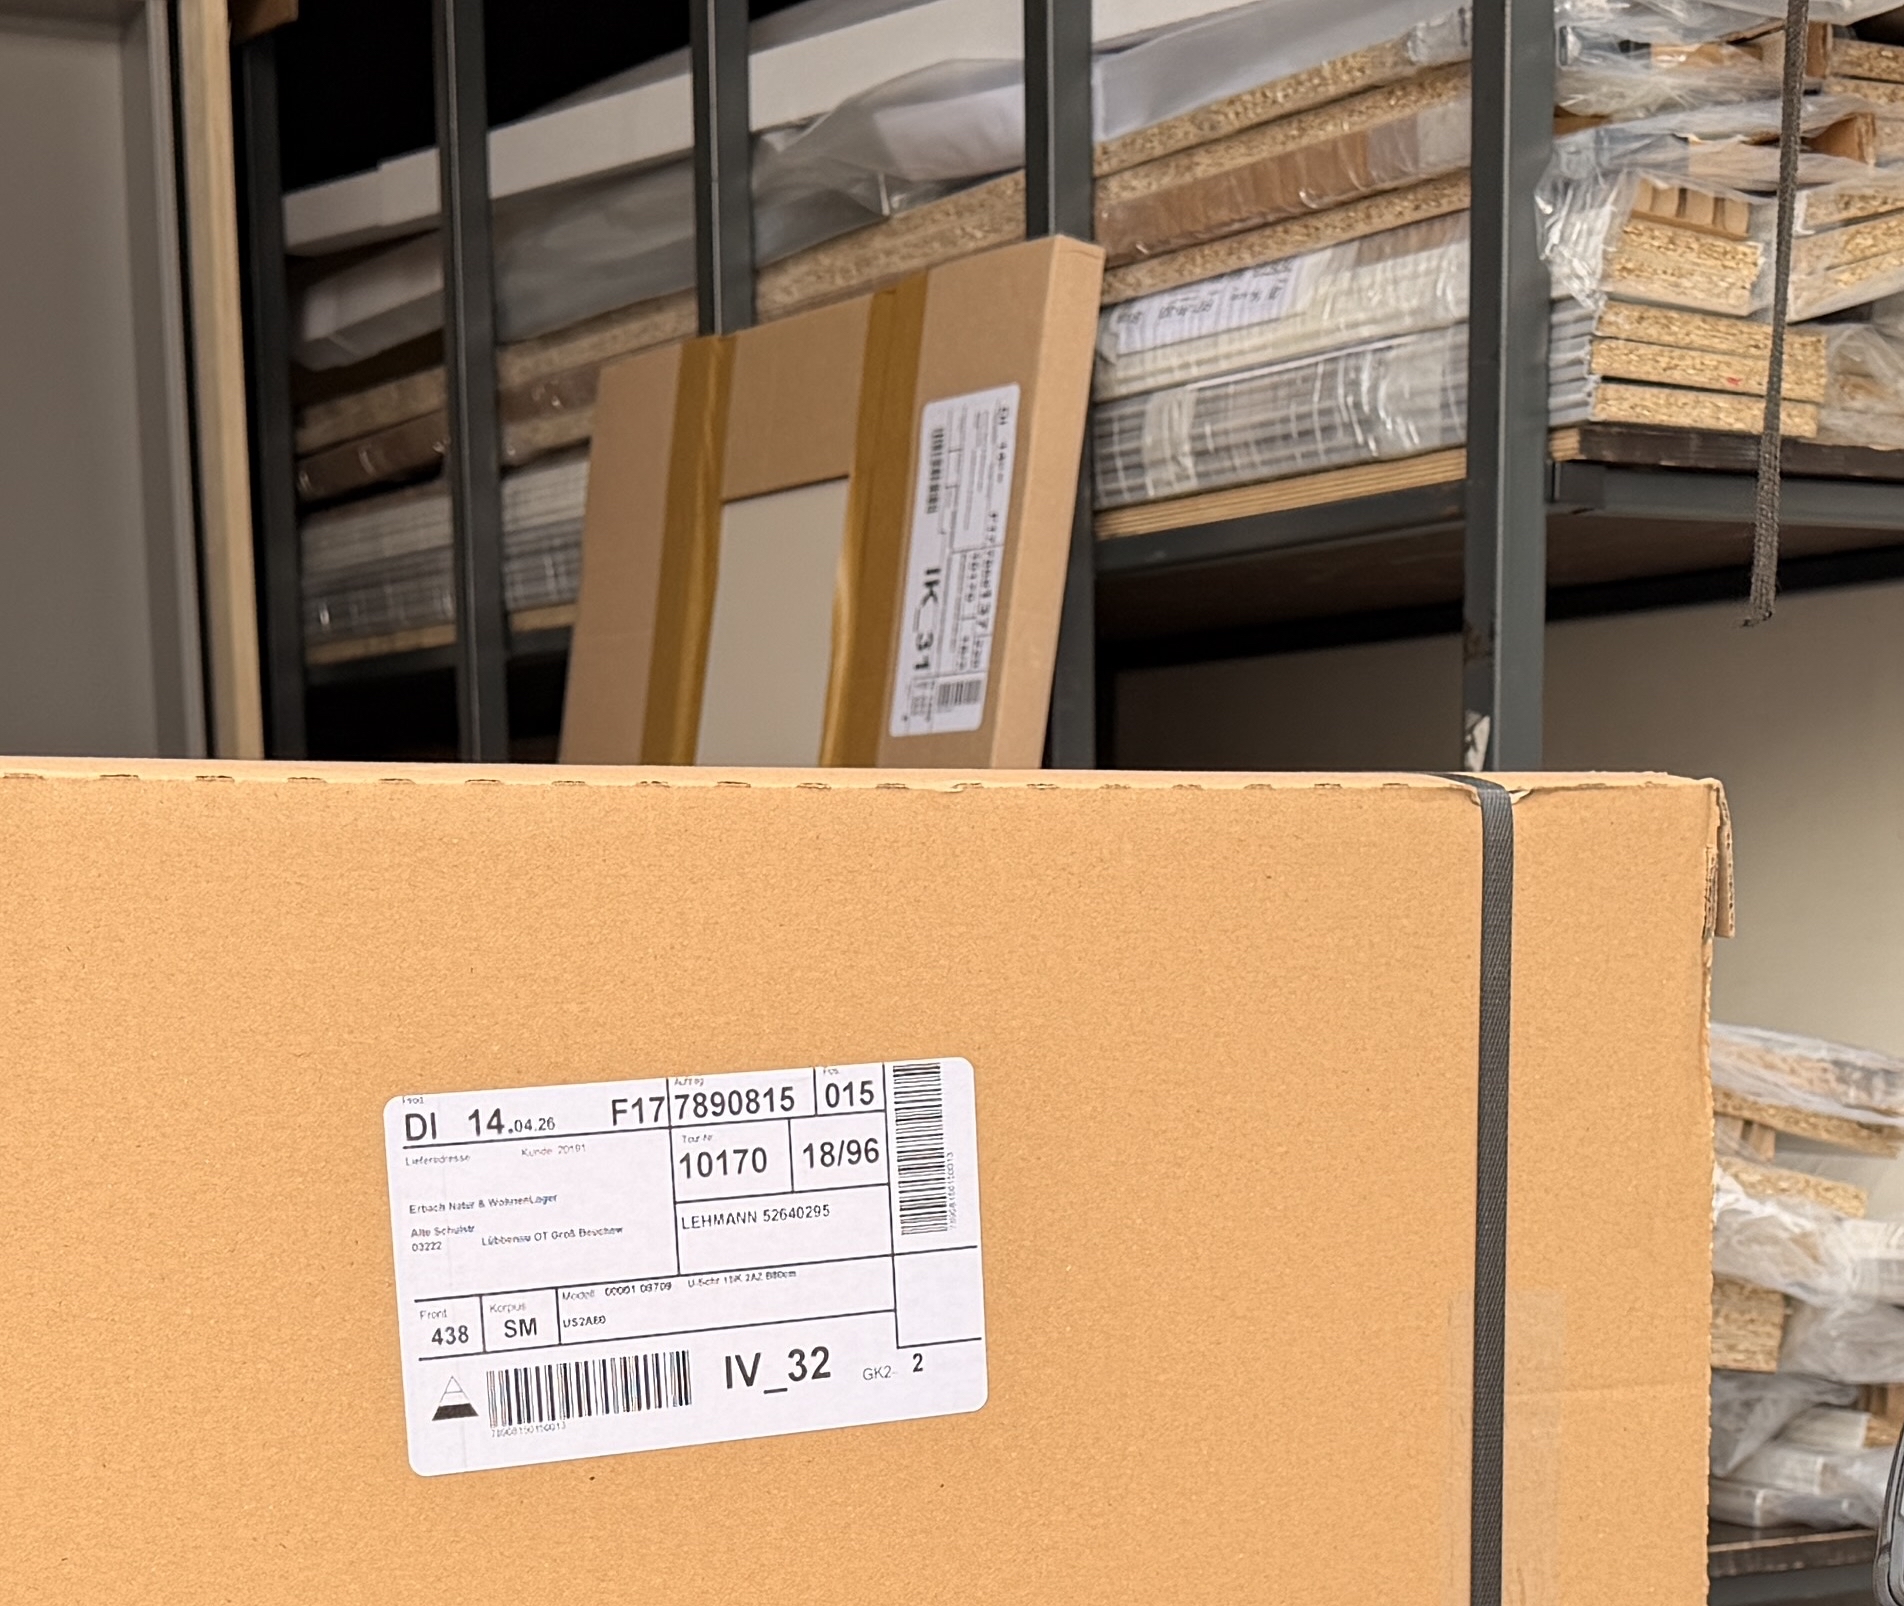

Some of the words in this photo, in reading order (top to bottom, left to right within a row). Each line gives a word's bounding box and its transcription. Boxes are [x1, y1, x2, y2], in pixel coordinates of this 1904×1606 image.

[673, 1085, 795, 1121] 7890815
[823, 1079, 875, 1109] 015
[403, 1110, 437, 1142] DI
[609, 1094, 666, 1127] F17
[677, 1145, 769, 1180] 10170
[801, 1135, 880, 1170] 18/96
[681, 1210, 758, 1230] LEHMANN
[761, 1203, 831, 1223] 52640295
[533, 1230, 549, 1242] OT
[429, 1323, 470, 1347] 438
[503, 1316, 538, 1339] SM
[724, 1343, 832, 1399] IV_32
[911, 1351, 924, 1373] 2
